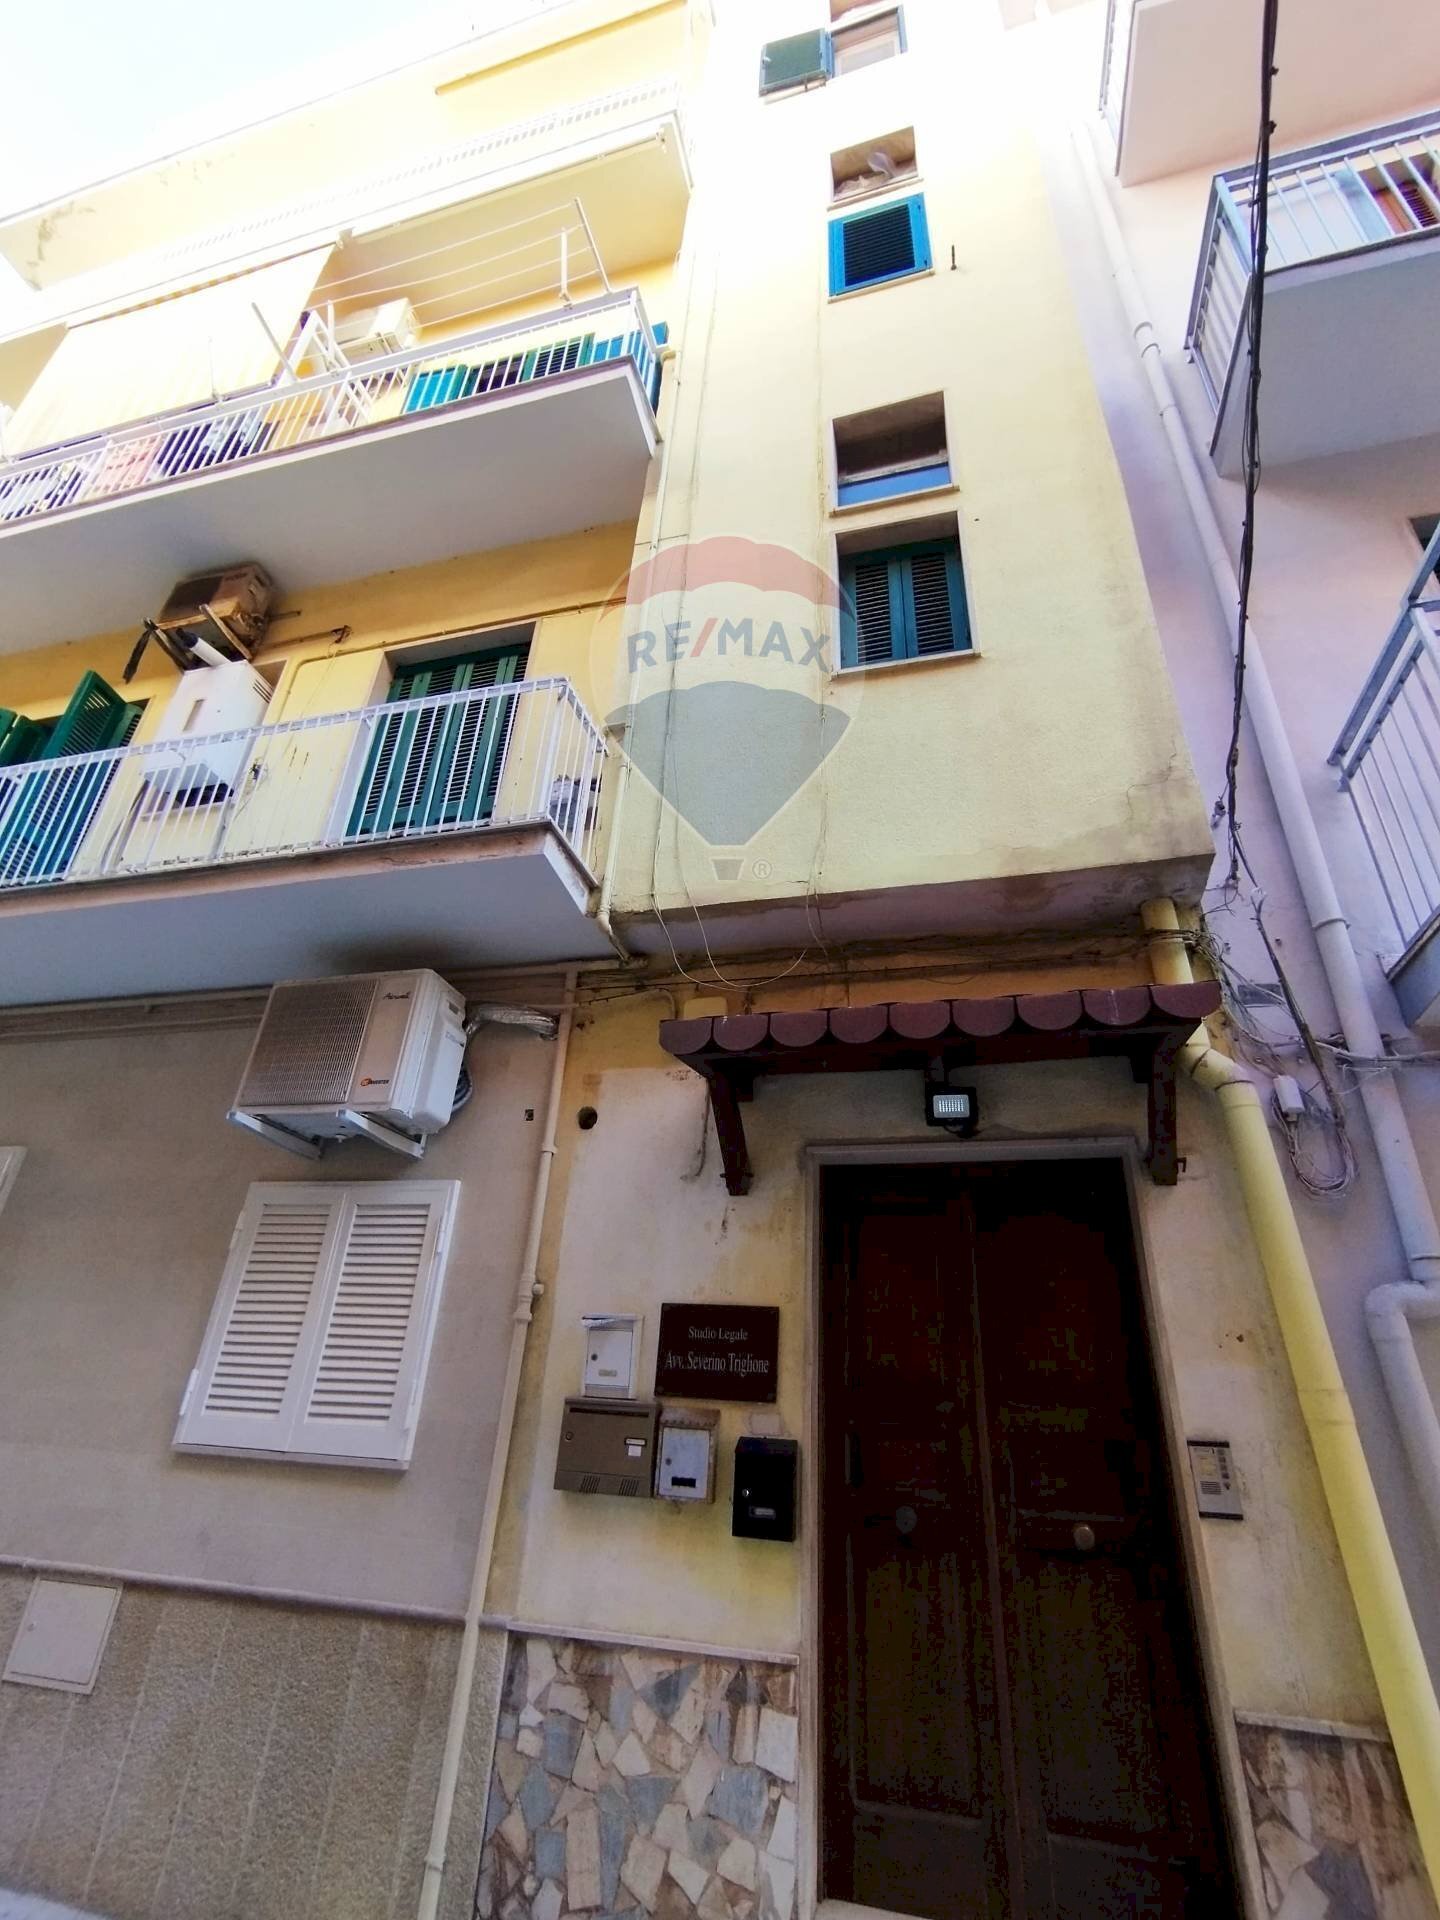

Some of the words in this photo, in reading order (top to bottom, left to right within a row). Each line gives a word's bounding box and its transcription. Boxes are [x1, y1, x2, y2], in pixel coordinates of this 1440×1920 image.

[688, 1326, 716, 1339] Studio
[719, 1328, 748, 1342] Legale
[687, 1351, 727, 1372] Severino
[728, 1353, 769, 1378] Triglione
